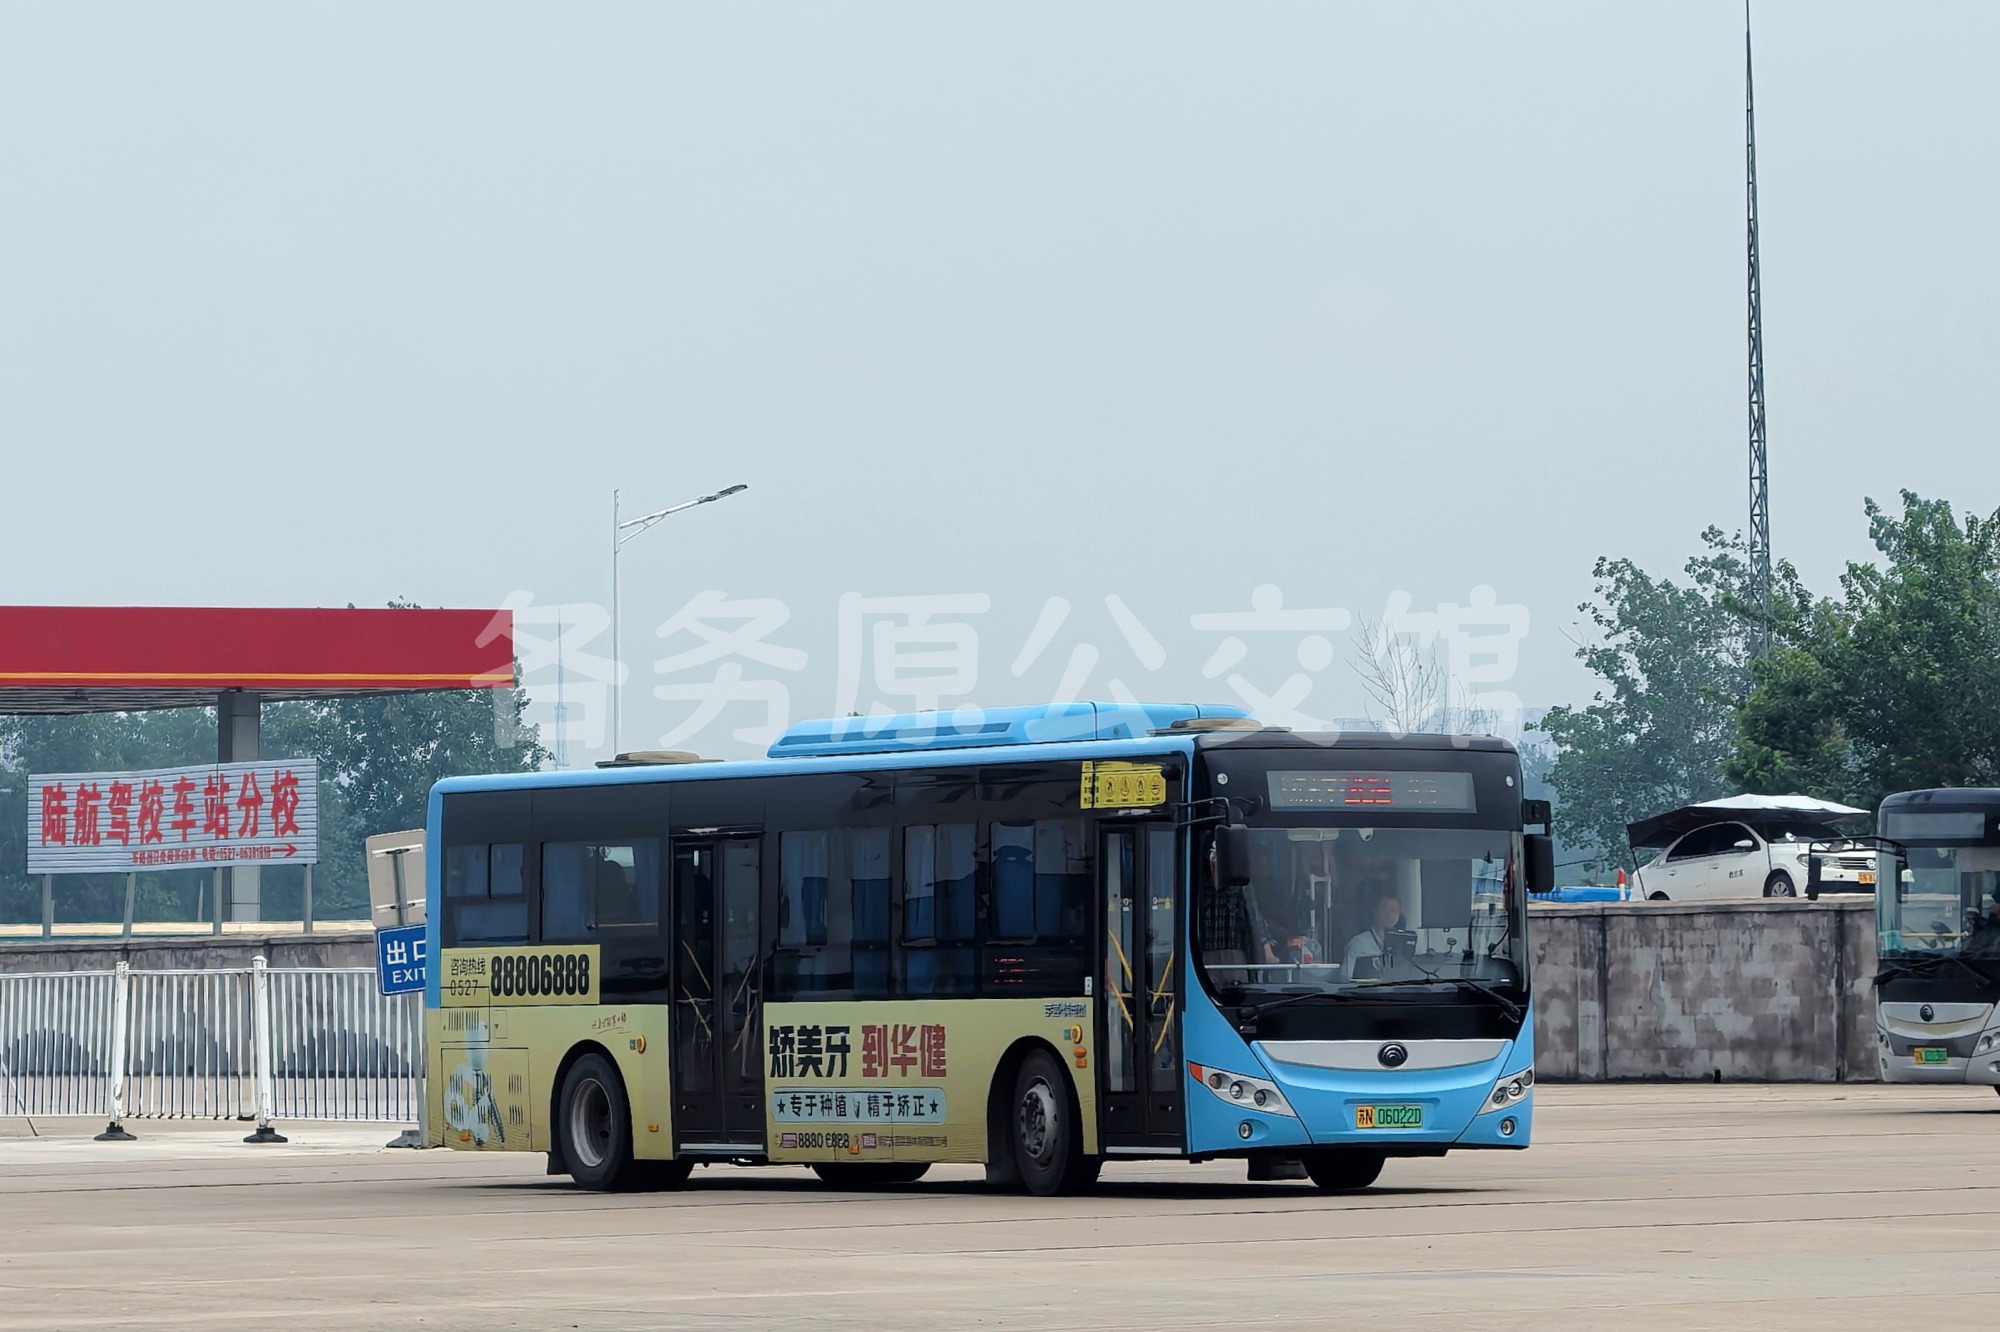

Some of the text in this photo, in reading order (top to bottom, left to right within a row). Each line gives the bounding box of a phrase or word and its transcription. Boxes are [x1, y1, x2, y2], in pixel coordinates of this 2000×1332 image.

[42, 770, 300, 847] 陆航驾校车站分校
[392, 967, 426, 984] EXIT
[450, 957, 486, 977] 咨询热线
[491, 954, 590, 997] 88806888
[450, 979, 478, 997] 0527
[769, 1024, 947, 1078] 矫美牙 到华健
[790, 1094, 925, 1117] 专于种植 精于矫正
